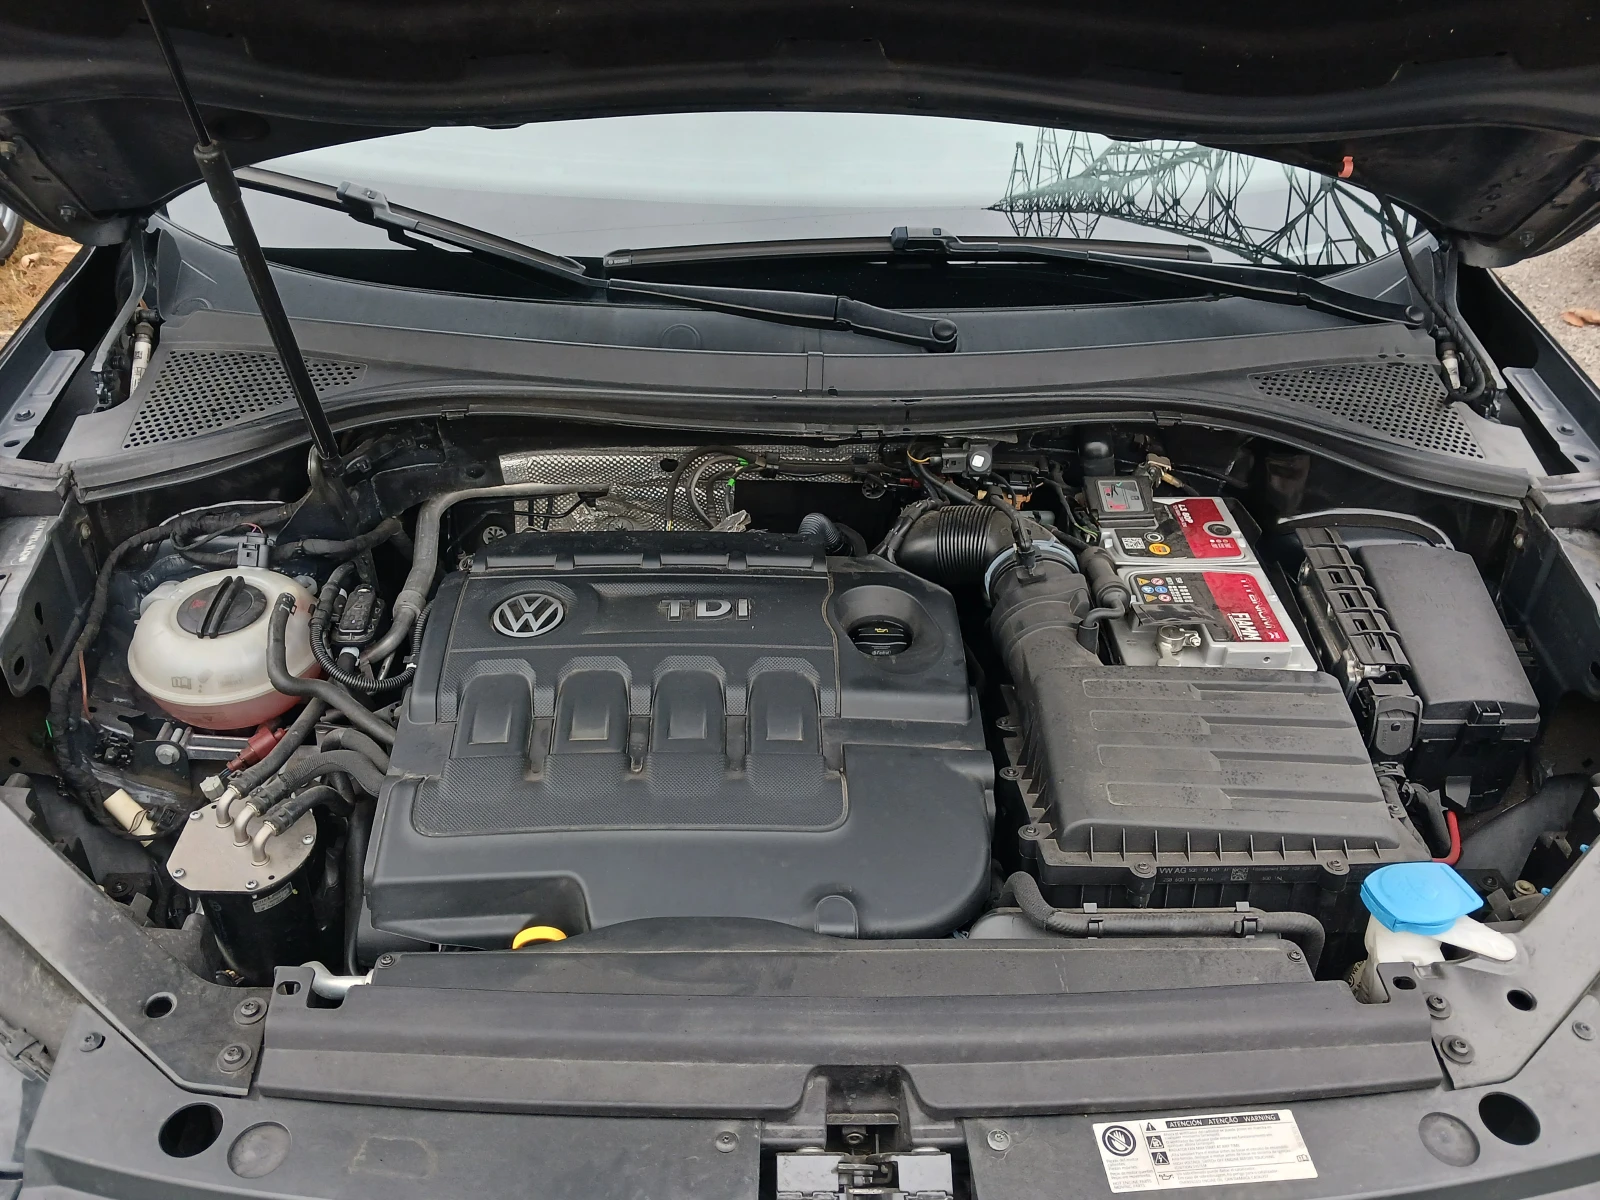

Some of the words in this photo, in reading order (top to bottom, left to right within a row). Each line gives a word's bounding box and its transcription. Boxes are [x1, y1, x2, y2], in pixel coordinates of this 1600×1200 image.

[493, 593, 564, 637] VW
[661, 599, 750, 620] TDI
[1231, 612, 1262, 640] FIAMM
[1169, 1119, 1203, 1128] ATENCIÓN
[1208, 1116, 1239, 1125] ATENÇÃO
[1243, 1114, 1276, 1122] WARNING
